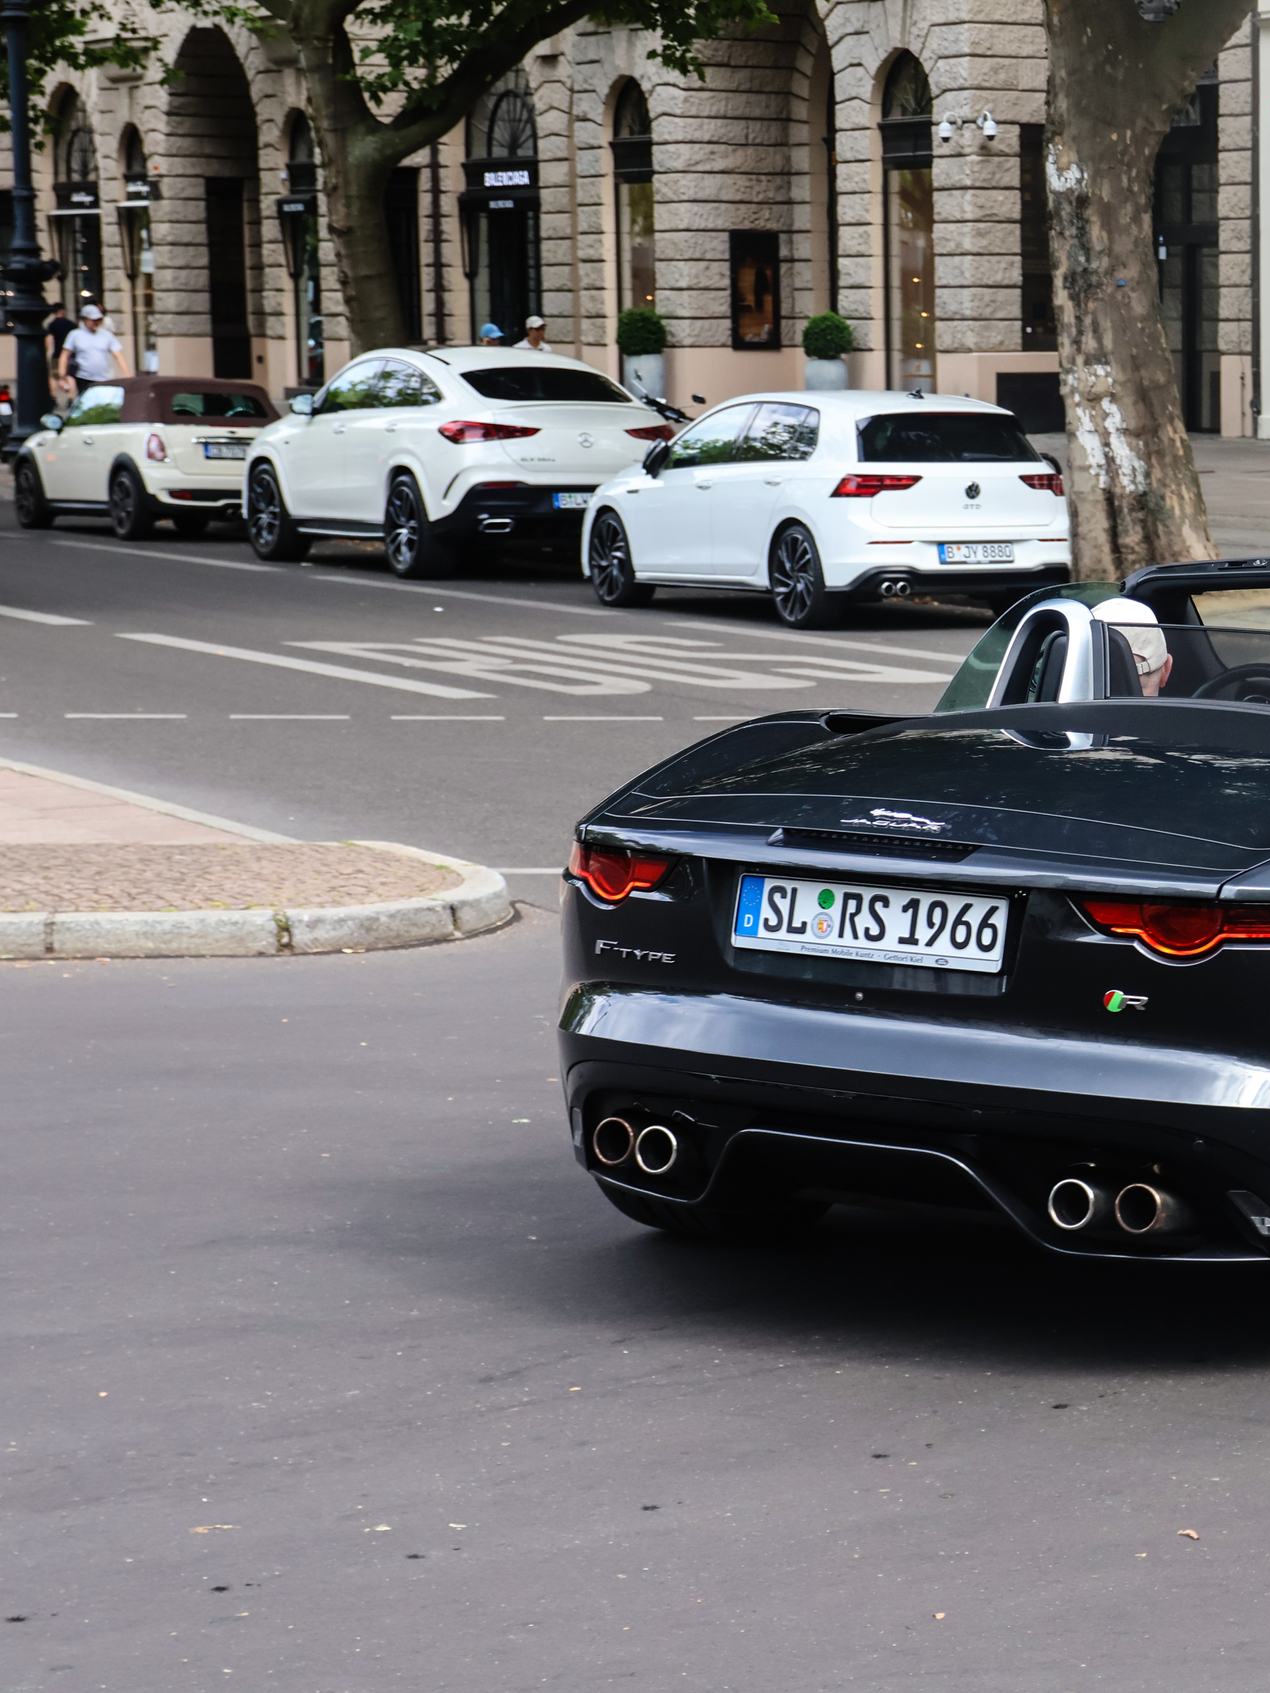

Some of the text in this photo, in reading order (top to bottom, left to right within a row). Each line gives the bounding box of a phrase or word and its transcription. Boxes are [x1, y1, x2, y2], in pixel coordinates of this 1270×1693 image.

[946, 545, 1012, 559] B JY 8880
[744, 913, 754, 928] D
[763, 884, 999, 953] SL RS 1966
[594, 939, 677, 964] F-TYPE
[801, 945, 829, 955] Premium
[831, 947, 853, 957] Mobile
[1118, 994, 1149, 1011] R
